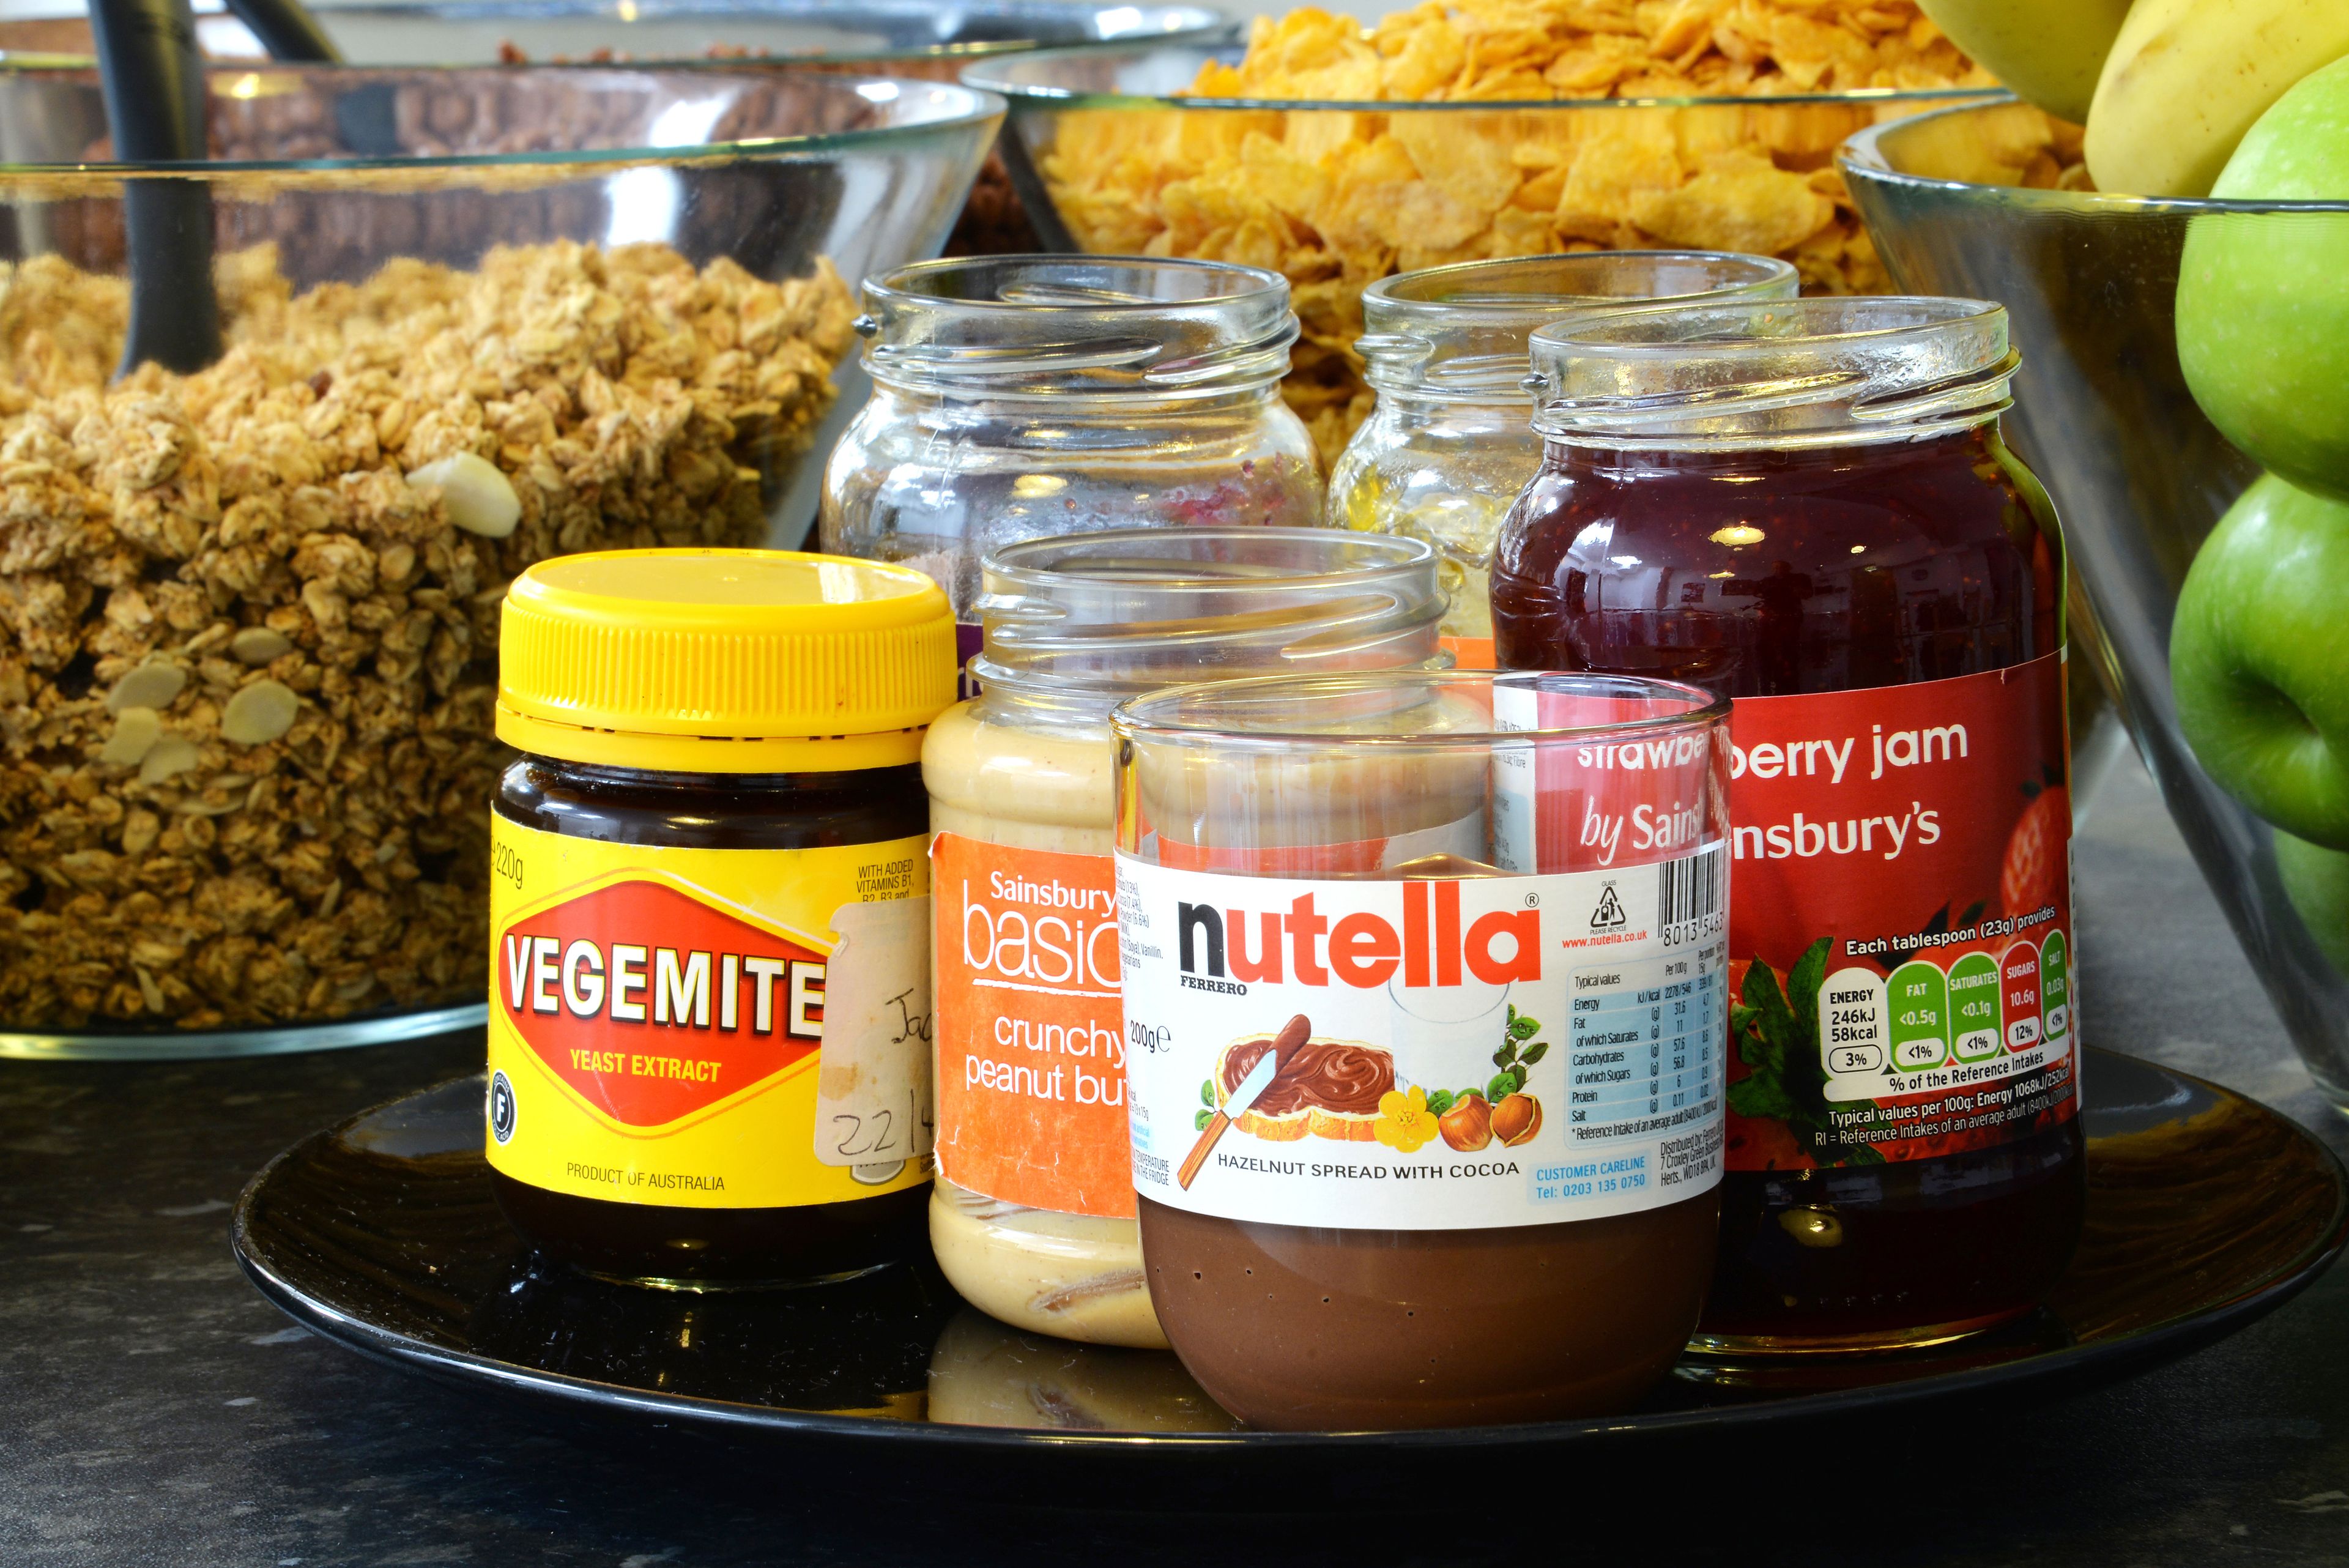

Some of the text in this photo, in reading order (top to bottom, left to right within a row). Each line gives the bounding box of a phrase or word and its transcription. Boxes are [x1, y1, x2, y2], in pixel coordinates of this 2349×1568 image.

[1871, 723, 1969, 780] jam
[1580, 795, 1624, 866] by
[858, 864, 883, 879] WITH
[885, 858, 913, 875] ADDED
[856, 875, 899, 893] VITAMINS
[902, 874, 914, 887] B1,
[990, 871, 1116, 918] Sainsbury
[1178, 880, 1541, 989] nutella
[1562, 930, 1647, 948] www.nutella.co.uk
[1608, 925, 1627, 934] RECYCLE
[1846, 907, 2055, 956] Each tablespoon (23g) provides
[2007, 960, 2035, 979] SUGARS
[2049, 951, 2061, 966] SALT
[507, 933, 828, 1039] VEGEMITE
[1180, 975, 1247, 996] FERRERO
[1575, 974, 1620, 990] Typical values
[1906, 983, 1926, 997] FAT
[1950, 972, 1997, 991] SATURATES
[1574, 999, 1600, 1011] Energy
[1830, 989, 1874, 1005] ENERGY
[1961, 1000, 1991, 1017] <0.1g
[2010, 989, 2034, 1007] 10.6g
[1574, 1017, 1586, 1029] Fat
[1675, 1001, 1686, 1015] 31.6
[1831, 1008, 1876, 1025] 246kJ
[1899, 1011, 1937, 1026] <0.5g
[995, 1016, 1126, 1069] crunchy
[1130, 1020, 1154, 1053] 200g
[1576, 1035, 1584, 1047] of
[1585, 1033, 1607, 1047] which
[1608, 1031, 1638, 1044] Saturates
[1677, 1020, 1683, 1032] 11
[1831, 1025, 1877, 1042] 58kcal
[1967, 1036, 1987, 1050] <1%
[2015, 1025, 2033, 1040] 12%
[1573, 1051, 1624, 1066] Carbohydrates
[1674, 1037, 1685, 1051] 57.6
[1845, 1052, 1867, 1066] 3%
[1908, 1046, 1932, 1059] <1%
[570, 1049, 722, 1083] YEAST EXTRACT
[1576, 1072, 1584, 1084] of
[1584, 1071, 1606, 1083] which
[1607, 1069, 1630, 1082] Sugars
[1890, 1052, 2043, 1091] % of the Reference Intakes
[966, 1053, 1127, 1106] peanut bu
[1572, 1091, 1597, 1103] Protein
[1677, 1075, 1681, 1087] 6
[497, 1093, 506, 1122] F
[1572, 1110, 1586, 1122] Salt
[1673, 1093, 1683, 1107] 0.11
[1829, 1108, 1875, 1128] Typical
[1878, 1102, 1918, 1121] values
[1921, 1102, 1942, 1120] per
[1943, 1096, 1974, 1113] 100g:
[1977, 1089, 2013, 1107] Energy
[1576, 1112, 1683, 1140] Reference Intake of an average adult
[1815, 1132, 1827, 1146] RI
[1840, 1128, 1897, 1144] Reference
[1900, 1122, 1939, 1139] Intakes
[1941, 1120, 1952, 1133] of
[1954, 1118, 1966, 1131] an
[1969, 1110, 2005, 1129] average
[2007, 1104, 2026, 1120] adult
[1660, 1134, 1694, 1156] Distributed
[1136, 1149, 1170, 1172] TEMPERATURE
[1218, 1154, 1520, 1180] HAZELNUT SPREAD WITH COCOA
[1536, 1156, 1645, 1181] CUSTOMER CARELINE
[1661, 1156, 1665, 1170] 7
[1666, 1151, 1690, 1169] Croxley
[1690, 1146, 1704, 1162] Green
[567, 1162, 725, 1191] PRODUCT OF AUSTRALIA
[1149, 1169, 1170, 1186] FRIDGE
[1683, 1162, 1700, 1181] WD18
[1536, 1175, 1645, 1200] Tel: 0203 135 0750
